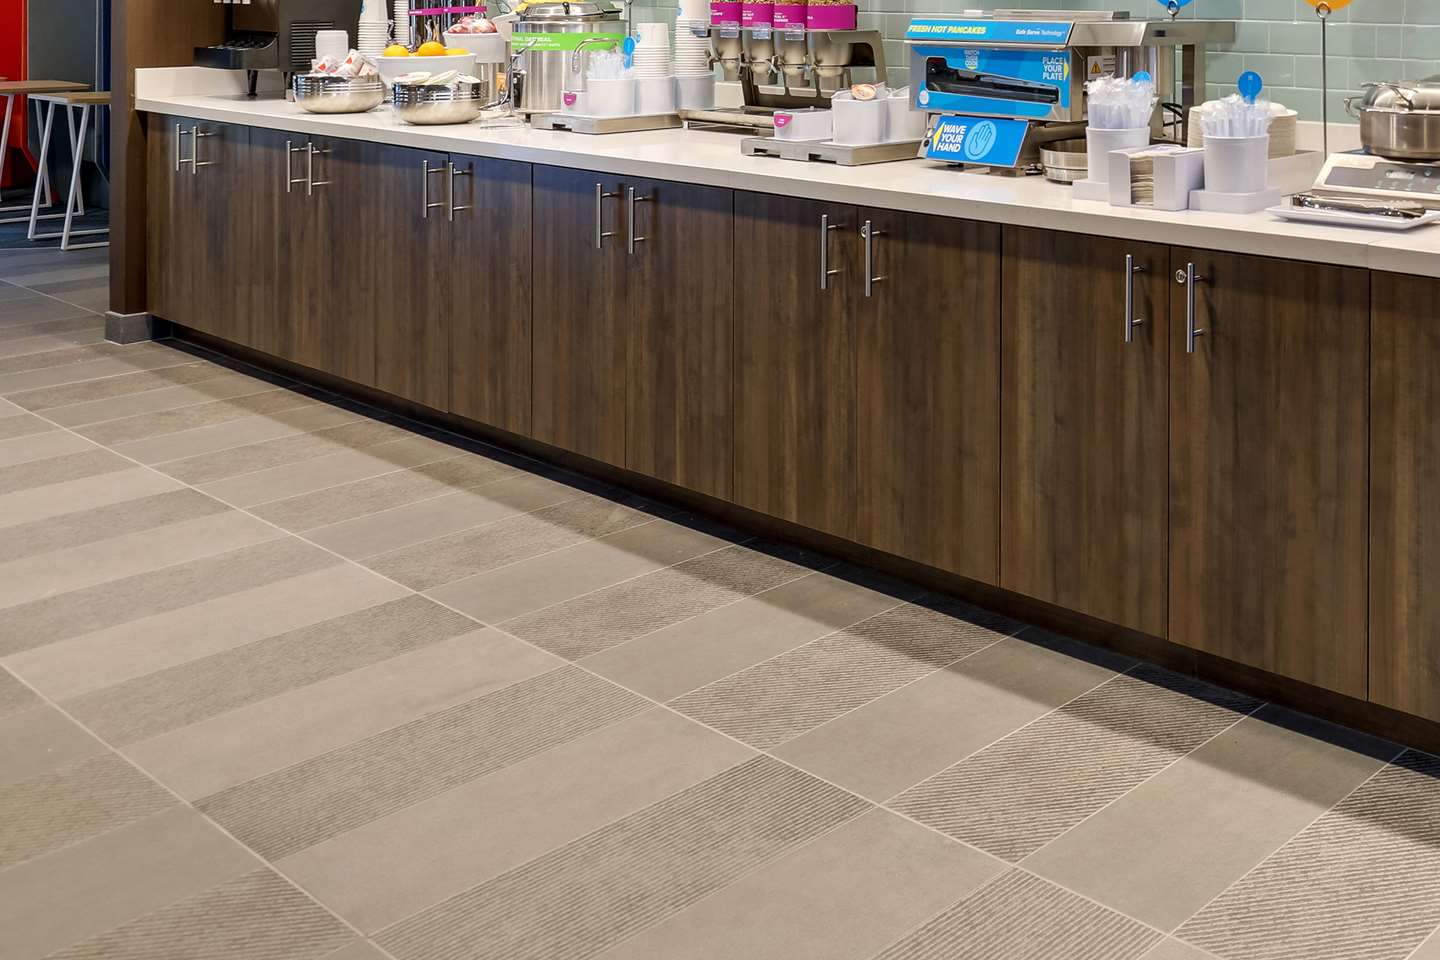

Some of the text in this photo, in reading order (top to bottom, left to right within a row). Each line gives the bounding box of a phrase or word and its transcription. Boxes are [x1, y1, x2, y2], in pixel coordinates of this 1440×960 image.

[908, 24, 987, 34] FRESH HOT PANCAKES
[1042, 56, 1063, 64] PLACE
[1043, 64, 1062, 72] YOUR
[1042, 72, 1062, 80] PLATE
[943, 125, 967, 135] WAVE
[941, 134, 964, 143] YOUR
[937, 143, 960, 152] HAND
